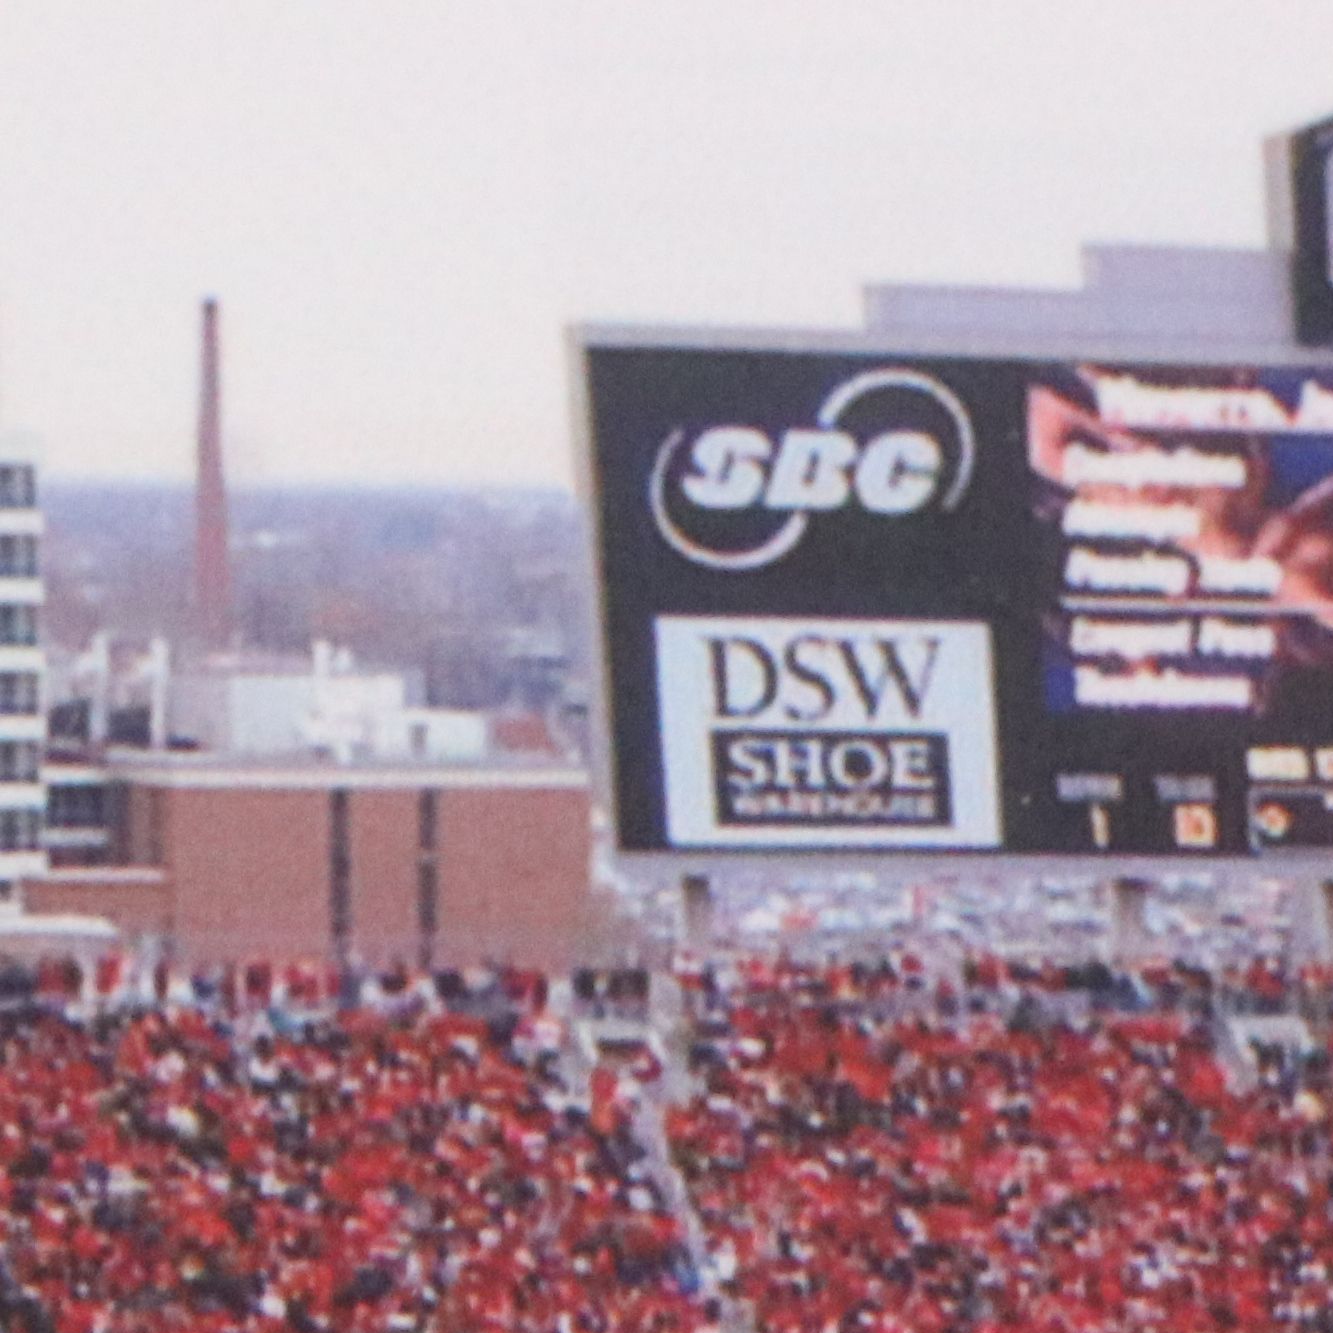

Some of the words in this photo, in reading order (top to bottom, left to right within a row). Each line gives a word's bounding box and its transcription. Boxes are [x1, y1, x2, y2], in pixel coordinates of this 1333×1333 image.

[682, 425, 942, 514] SBC
[705, 634, 940, 721] DSW
[727, 739, 936, 788] SHOE
